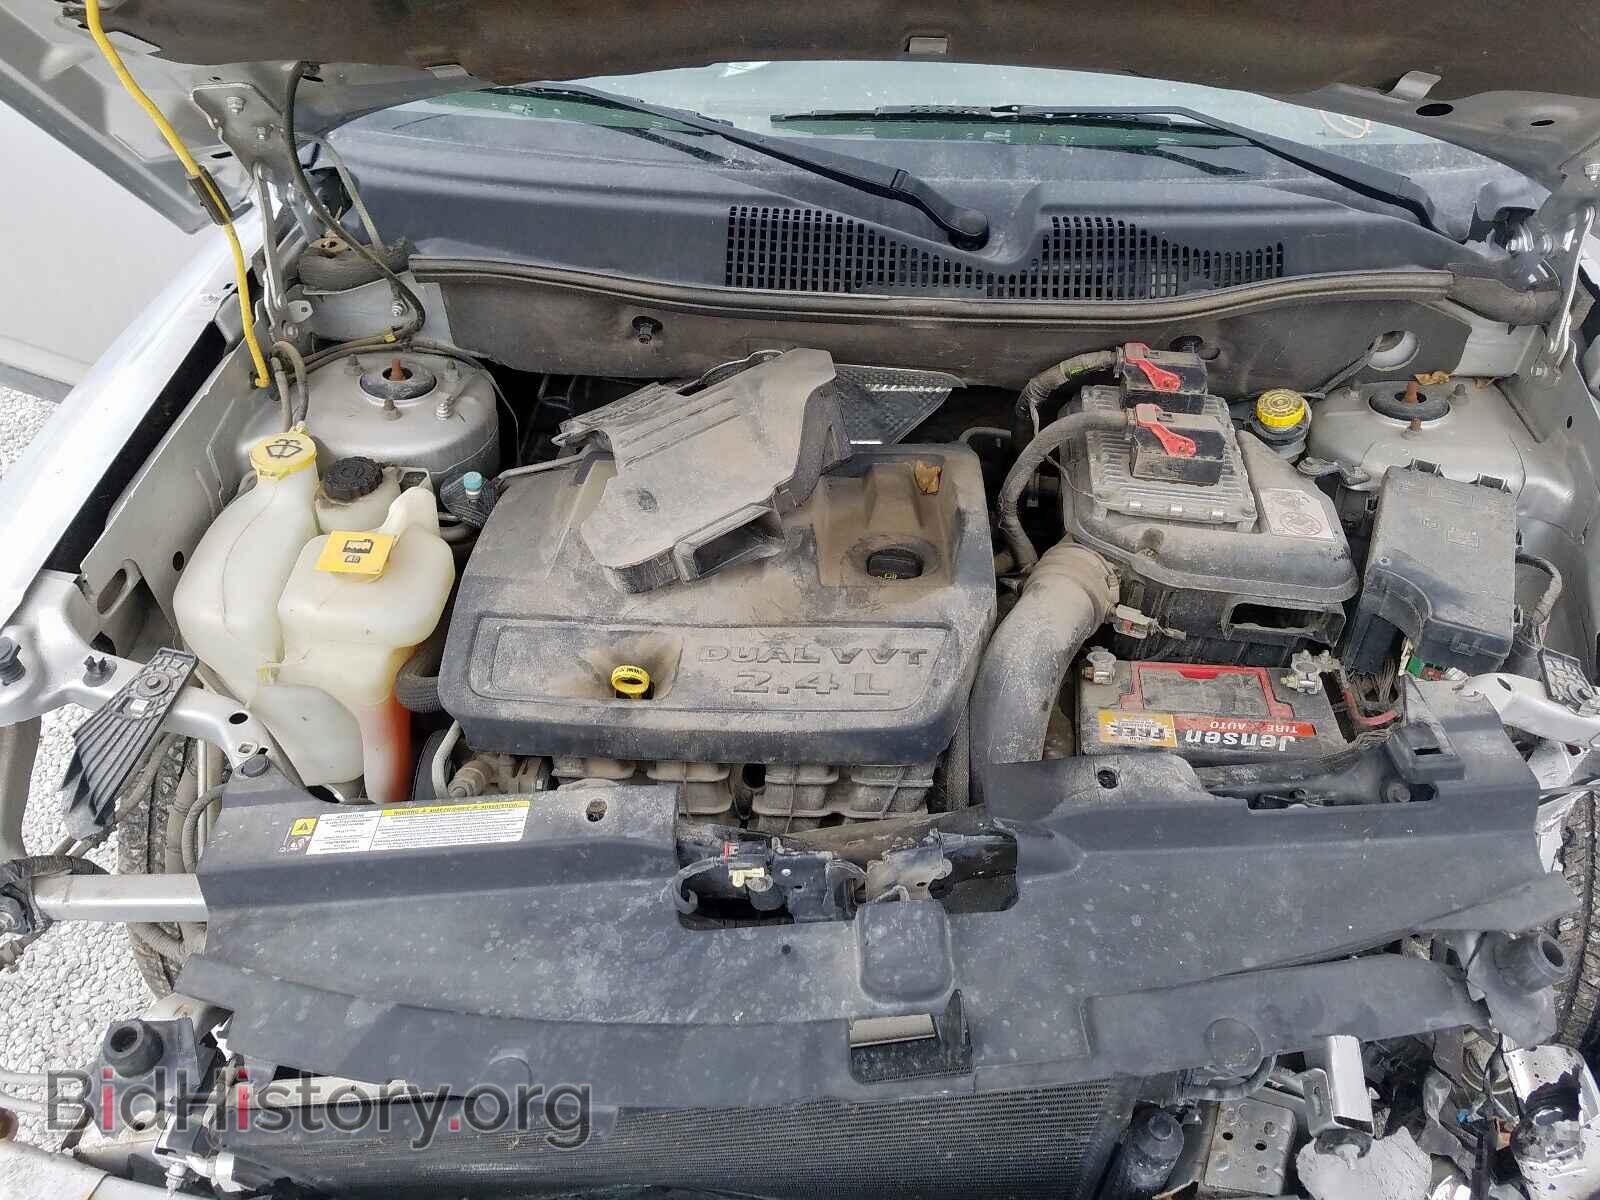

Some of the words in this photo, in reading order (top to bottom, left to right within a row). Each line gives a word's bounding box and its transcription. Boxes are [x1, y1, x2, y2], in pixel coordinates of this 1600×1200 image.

[701, 646, 820, 664] DUAL
[831, 648, 928, 665] VVT
[1209, 721, 1246, 732] AUTO
[1264, 723, 1298, 734] TIRE
[1185, 729, 1296, 751] Jensen
